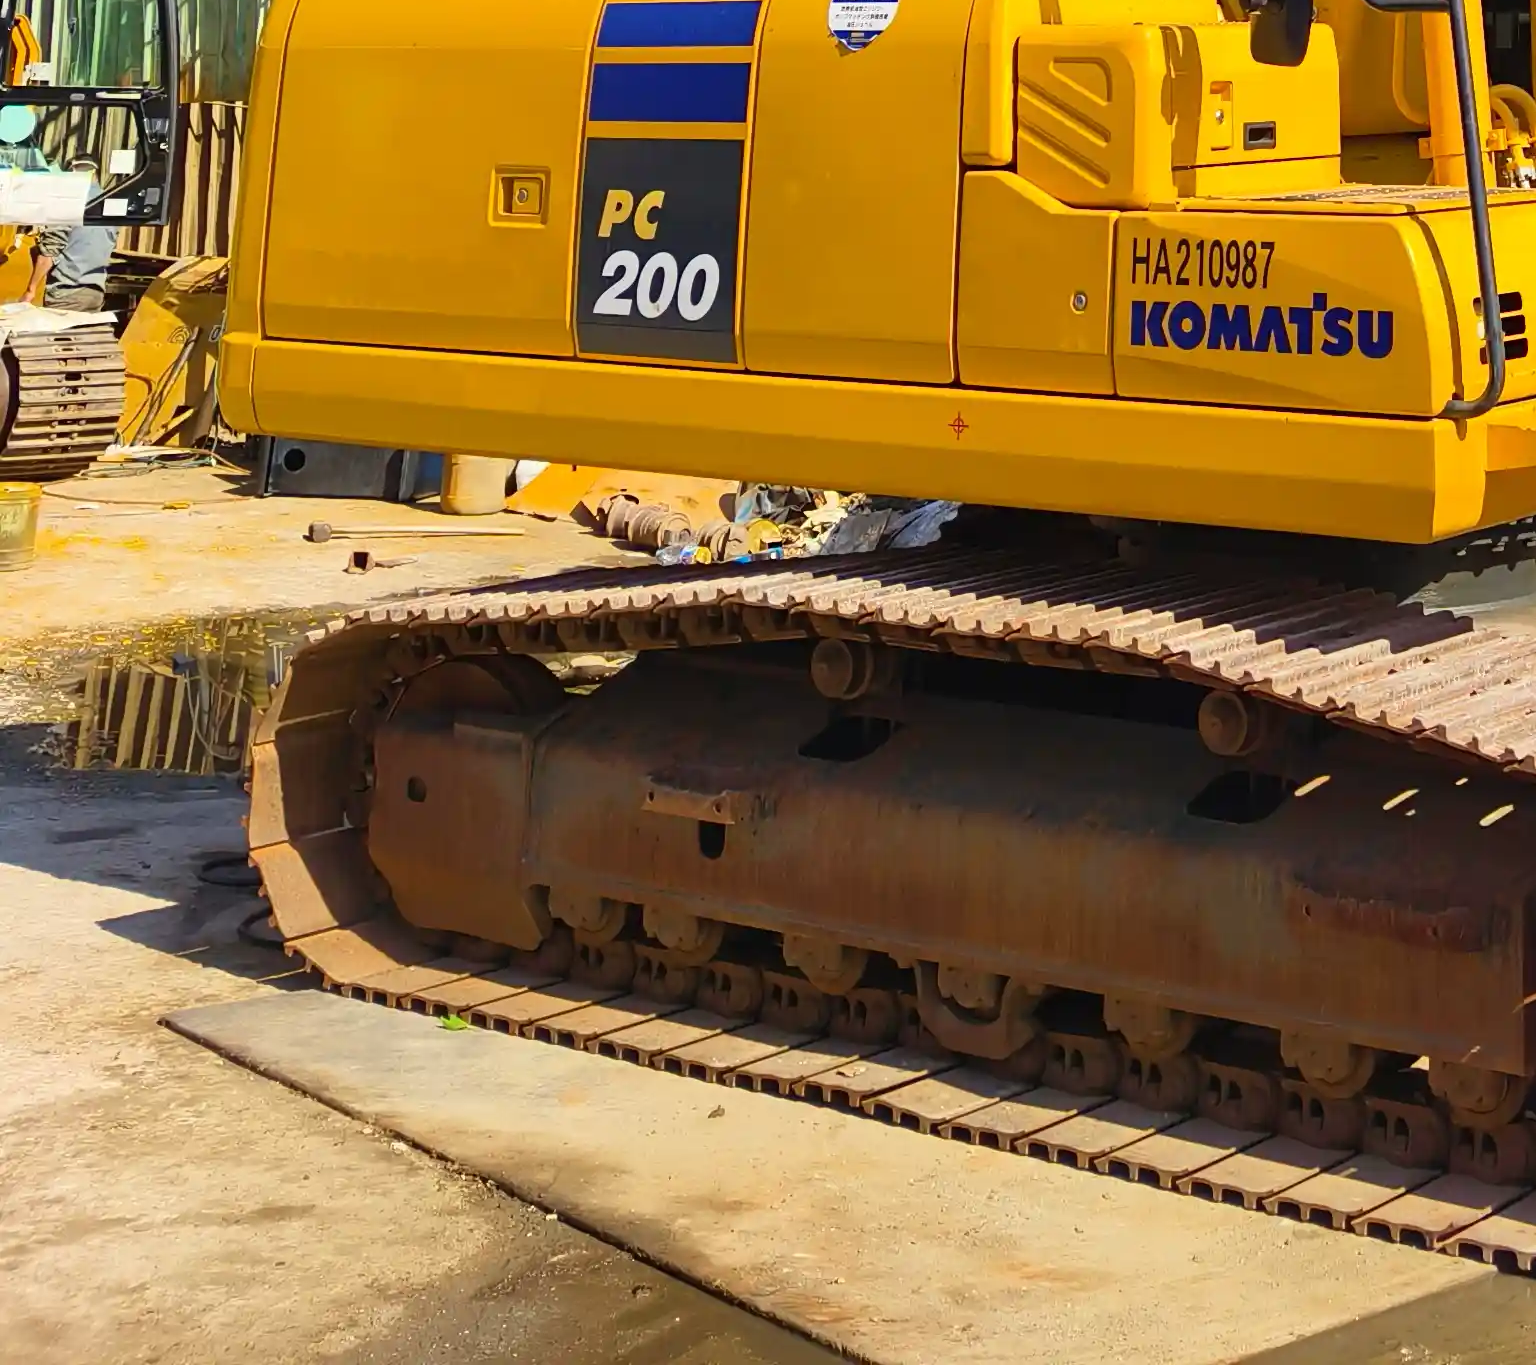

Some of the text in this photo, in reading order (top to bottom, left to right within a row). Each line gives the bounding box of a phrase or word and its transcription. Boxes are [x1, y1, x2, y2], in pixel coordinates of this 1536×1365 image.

[598, 189, 665, 240] PC
[593, 249, 720, 322] 200
[1131, 237, 1275, 289] HA210987
[1130, 291, 1394, 360] KOMATSU
